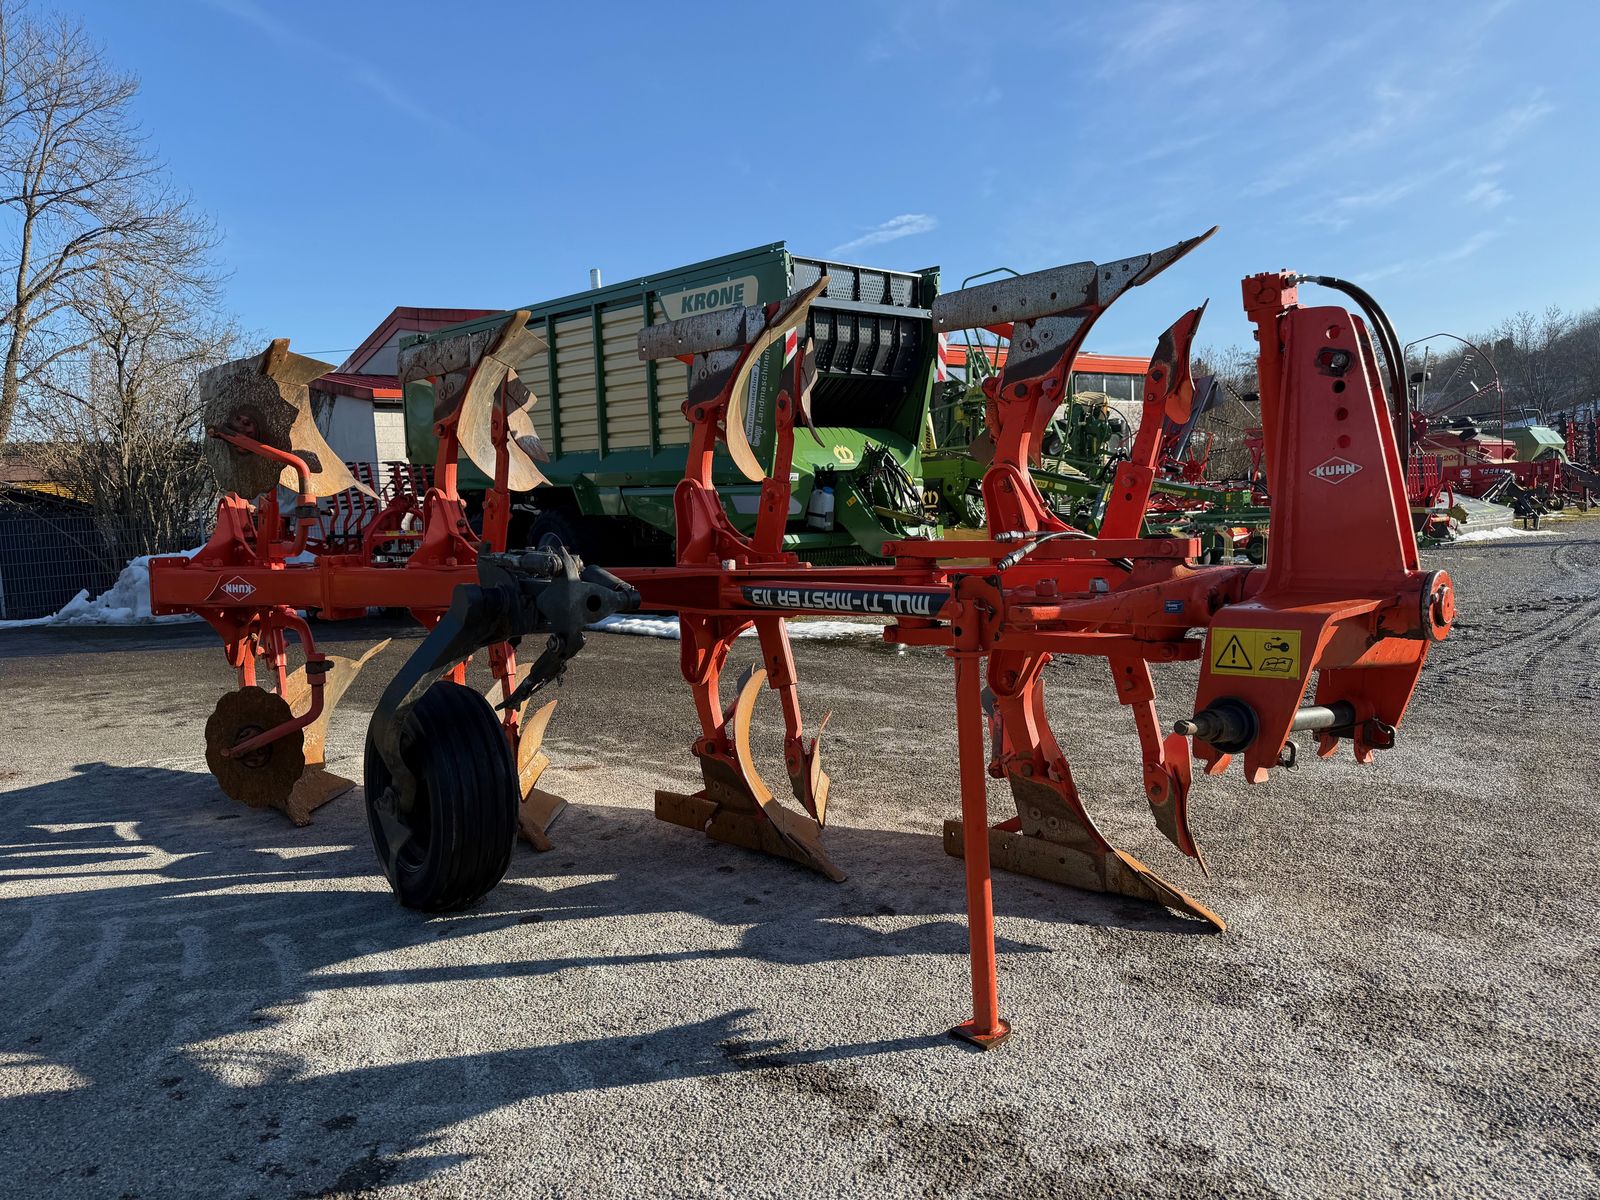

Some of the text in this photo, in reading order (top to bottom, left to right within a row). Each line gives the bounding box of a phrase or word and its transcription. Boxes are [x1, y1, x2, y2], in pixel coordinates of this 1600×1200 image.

[681, 283, 745, 314] KRONE
[757, 348, 771, 424] Landmaschinen
[1316, 464, 1355, 477] KUHN
[225, 584, 252, 594] KUHN
[751, 589, 931, 615] MULTI-MASTER 113
